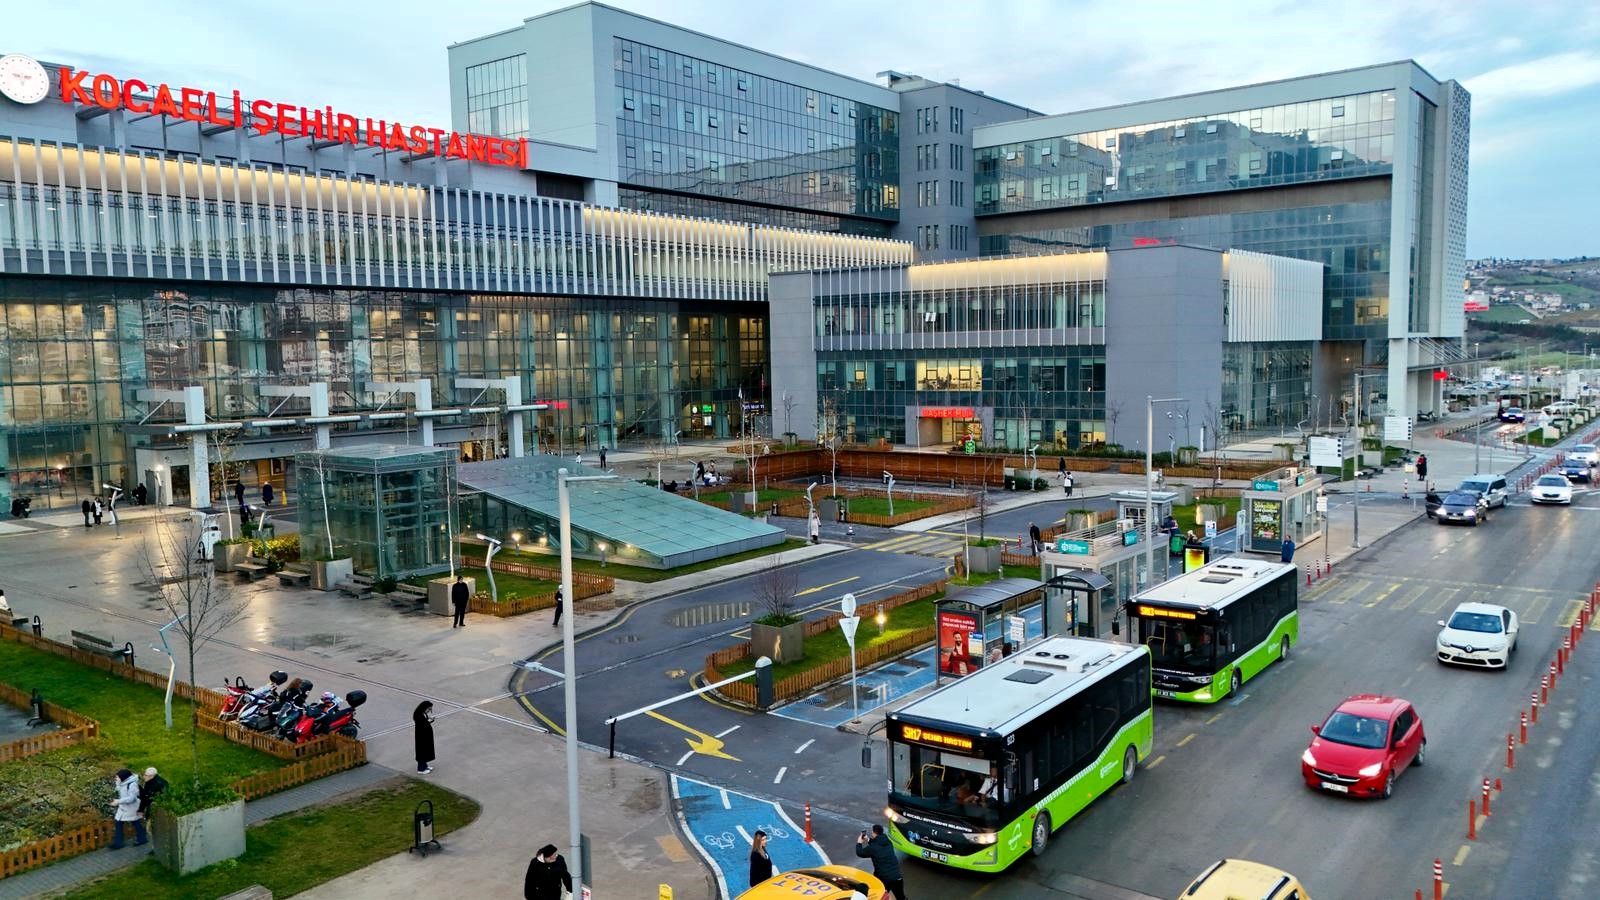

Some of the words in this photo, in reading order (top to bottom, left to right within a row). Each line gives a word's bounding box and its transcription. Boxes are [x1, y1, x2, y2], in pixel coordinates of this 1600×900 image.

[59, 66, 243, 128] KOCAELİ
[251, 99, 359, 145] ŞEHİR
[366, 117, 529, 168] HASTANESİ
